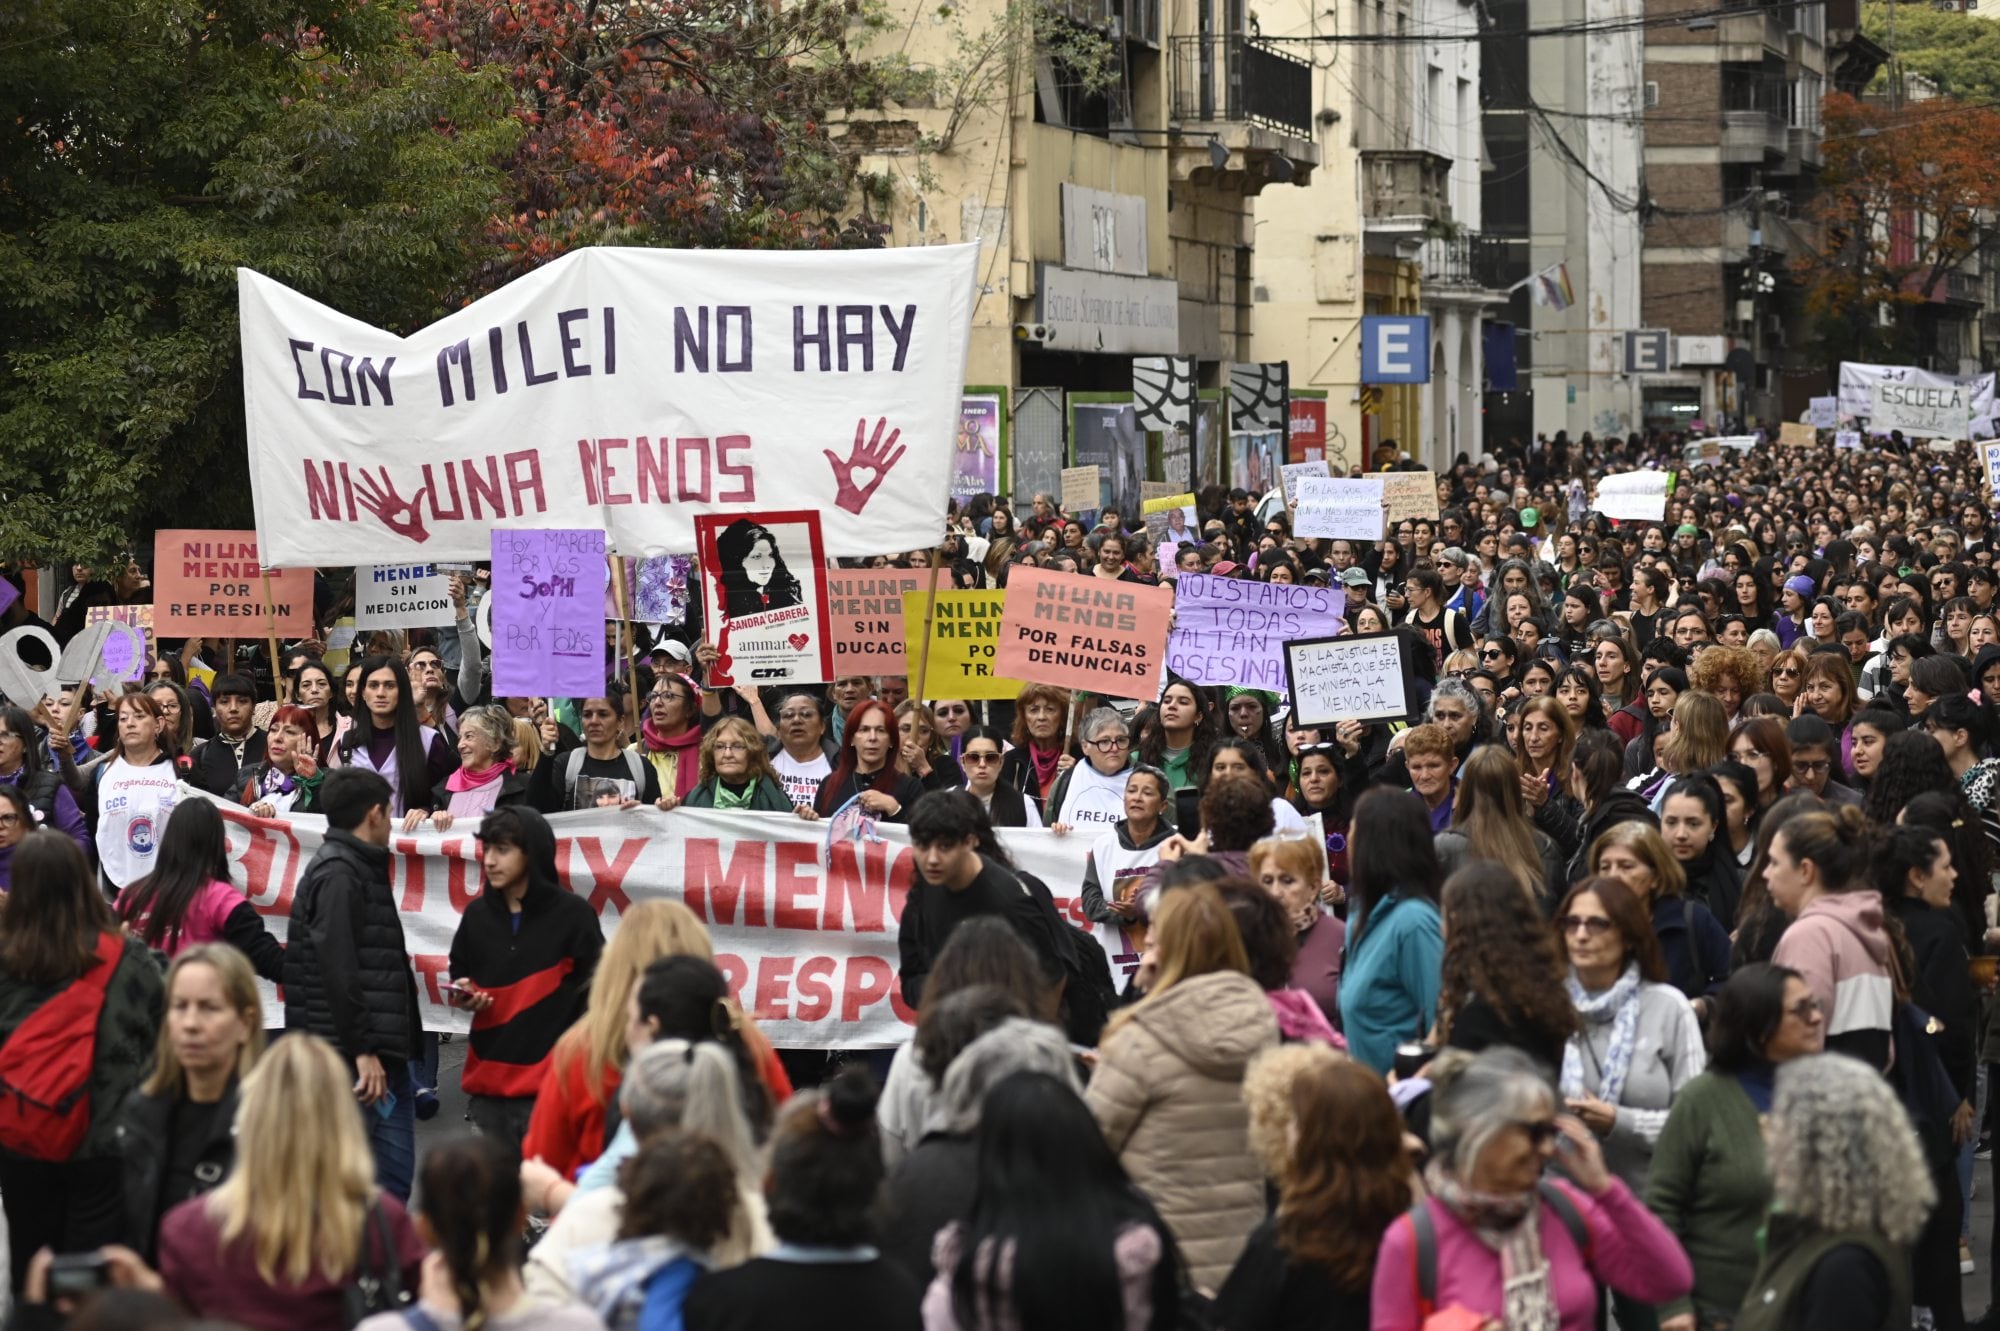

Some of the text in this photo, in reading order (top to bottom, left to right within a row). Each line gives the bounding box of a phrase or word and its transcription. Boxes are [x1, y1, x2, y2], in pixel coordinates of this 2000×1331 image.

[288, 304, 917, 407] CON MILEI NO HAY
[1377, 324, 1411, 374] E
[1634, 336, 1659, 370] E
[1881, 386, 1962, 409] ESCUELA
[303, 458, 357, 521] NI
[422, 448, 547, 521] UNA
[511, 553, 541, 574] POR
[209, 583, 250, 596] POR
[391, 585, 417, 596] SIN
[1177, 572, 1330, 613] NO ESTAMOS
[170, 603, 291, 617] REPRESION
[365, 599, 449, 615] MEDICACION
[830, 598, 902, 615] MENO
[729, 616, 767, 632] SANDRA
[767, 606, 810, 624] CABRERA
[1034, 602, 1137, 632] MENOS
[855, 620, 890, 634] SIN
[937, 621, 1001, 638] MEN
[507, 623, 542, 650] POR
[836, 641, 907, 655] DUCAC
[969, 644, 996, 658] PO
[1070, 635, 1147, 658] FALSAS
[1298, 643, 1398, 662] SI LA JUSTICIA ES
[750, 667, 788, 679] CTA
[961, 662, 994, 676] TR
[1352, 661, 1376, 675] QUE
[1378, 658, 1399, 672] SEA
[1297, 675, 1385, 696] FEMINISTA LA
[105, 796, 127, 811] CCC
